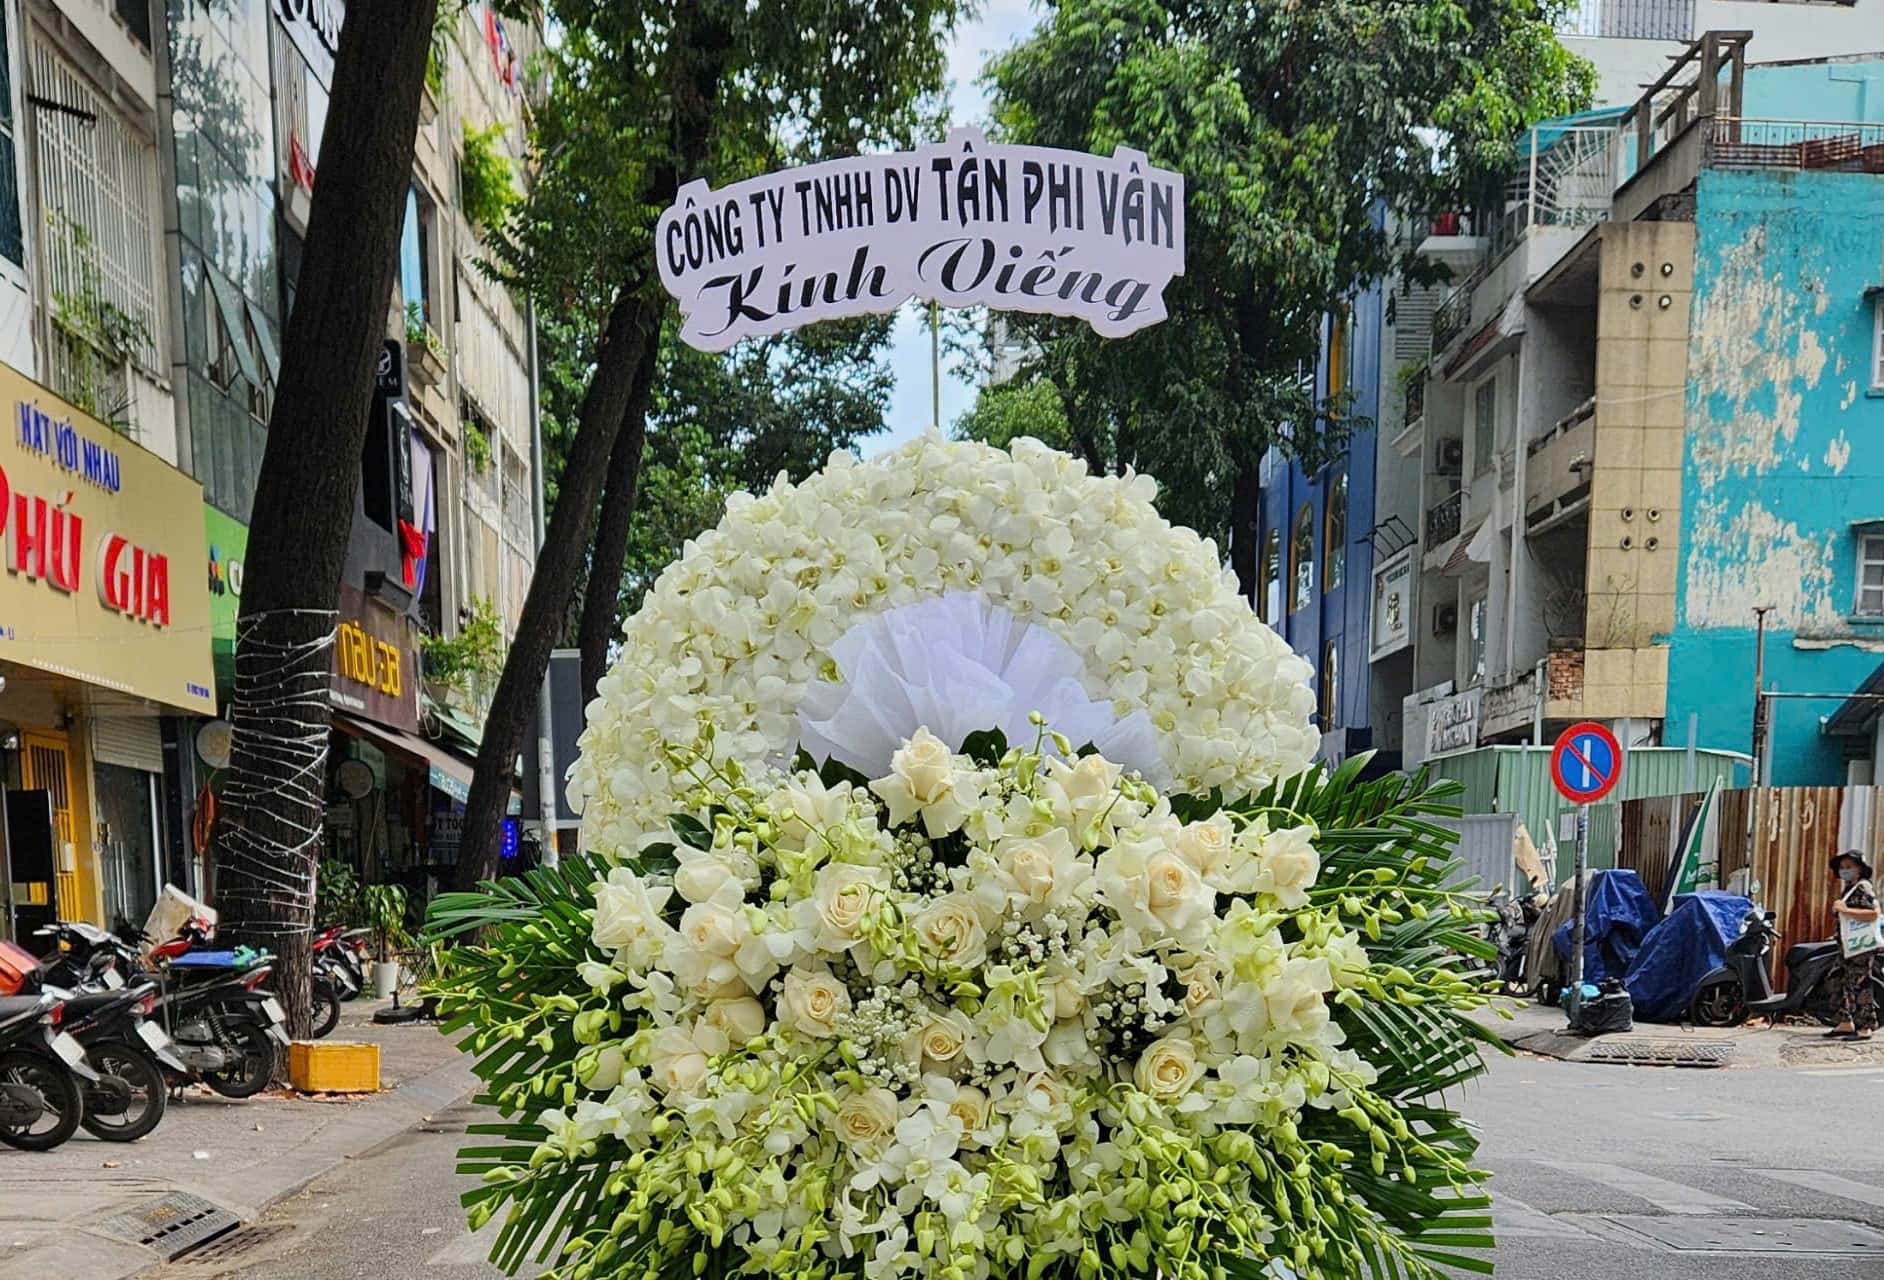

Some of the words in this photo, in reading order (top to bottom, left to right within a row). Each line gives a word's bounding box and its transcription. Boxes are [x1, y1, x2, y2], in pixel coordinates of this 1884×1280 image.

[666, 197, 743, 277] CÔNG
[749, 187, 784, 246] TY
[795, 171, 873, 236] TNHH
[885, 167, 920, 224] DV
[932, 141, 1009, 228] TÂN
[1023, 161, 1084, 234] PHI
[1097, 163, 1174, 248] VÂN
[697, 245, 893, 337] Kính
[917, 237, 1154, 321] Viếng
[19, 399, 50, 456] HÁT
[82, 437, 120, 492] NHAU
[99, 533, 169, 625] GIA
